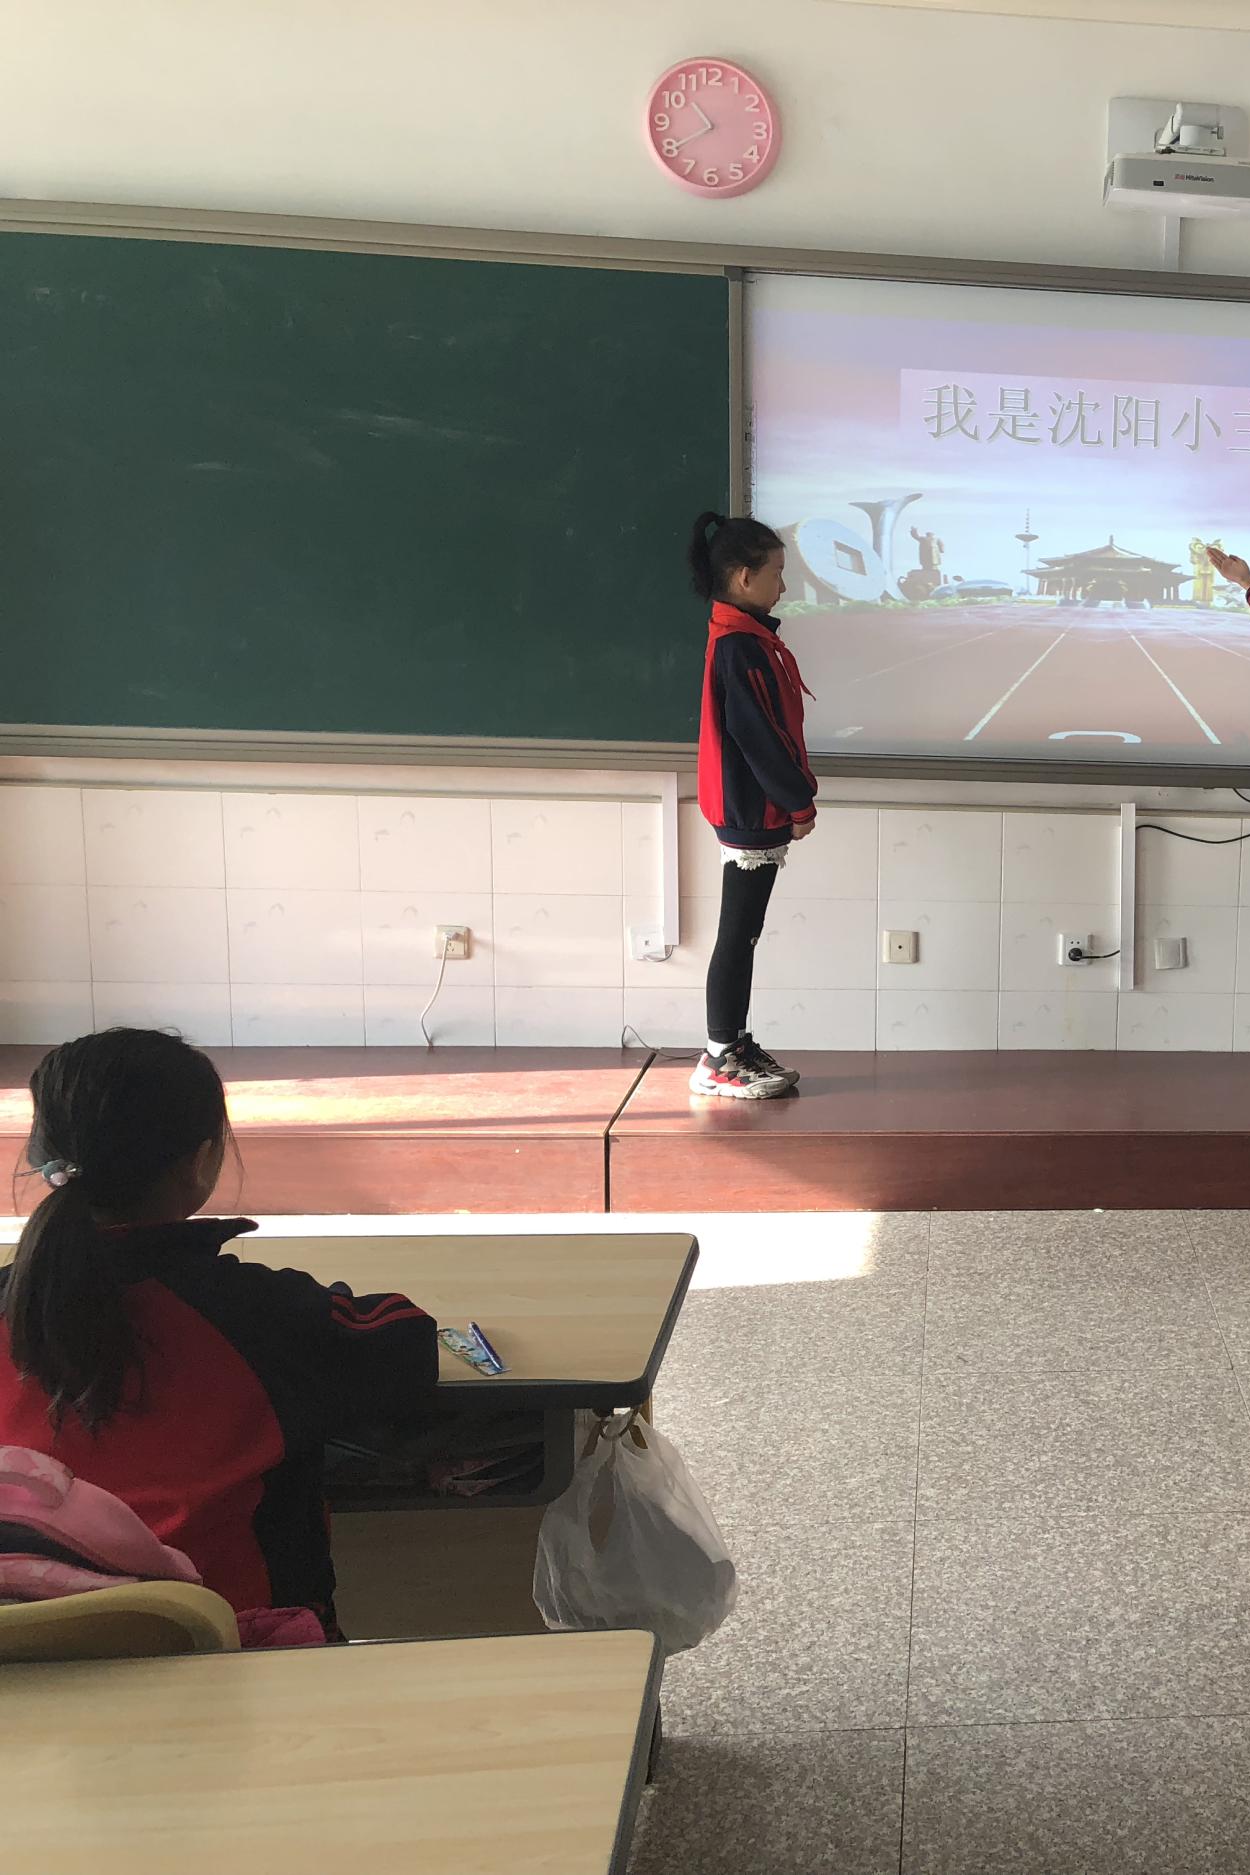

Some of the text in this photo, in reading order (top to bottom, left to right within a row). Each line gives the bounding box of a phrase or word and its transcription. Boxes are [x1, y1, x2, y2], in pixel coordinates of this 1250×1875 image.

[678, 73, 697, 91] 11
[698, 67, 723, 86] 12
[730, 77, 739, 94] 1
[662, 90, 686, 109] 10
[744, 94, 760, 112] 2
[654, 114, 670, 132] 9
[752, 122, 768, 140] 3
[662, 138, 679, 158] 8
[743, 144, 760, 164] 4
[682, 159, 696, 176] 7
[728, 164, 744, 180] 5
[702, 168, 719, 186] 6
